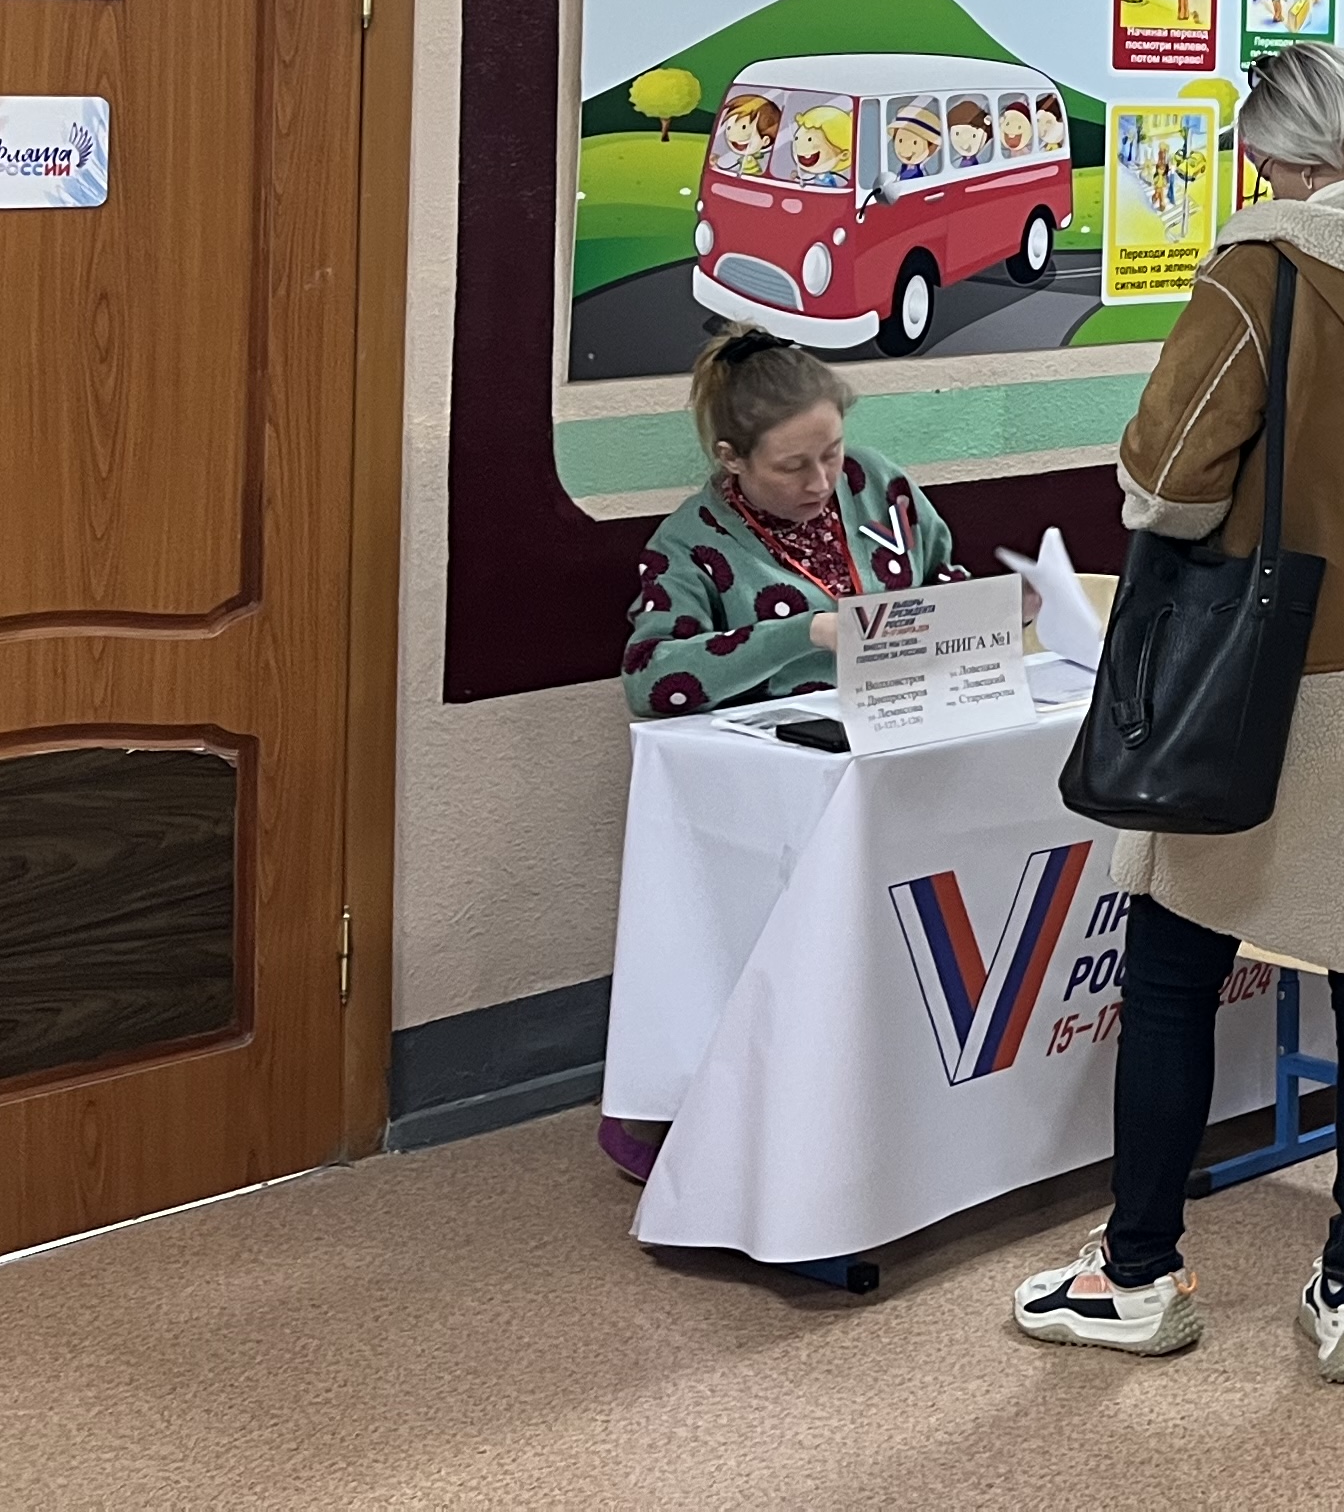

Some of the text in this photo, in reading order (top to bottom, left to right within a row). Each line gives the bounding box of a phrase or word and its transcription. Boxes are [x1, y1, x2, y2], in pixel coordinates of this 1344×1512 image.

[1125, 40, 1171, 52] посмотри
[1131, 54, 1160, 63] потом
[1120, 248, 1199, 261] Переходи дорогу
[1115, 262, 1198, 275] только на зелены
[1115, 276, 1194, 291] сигнал светофор
[935, 630, 1010, 656] КНИГА №1
